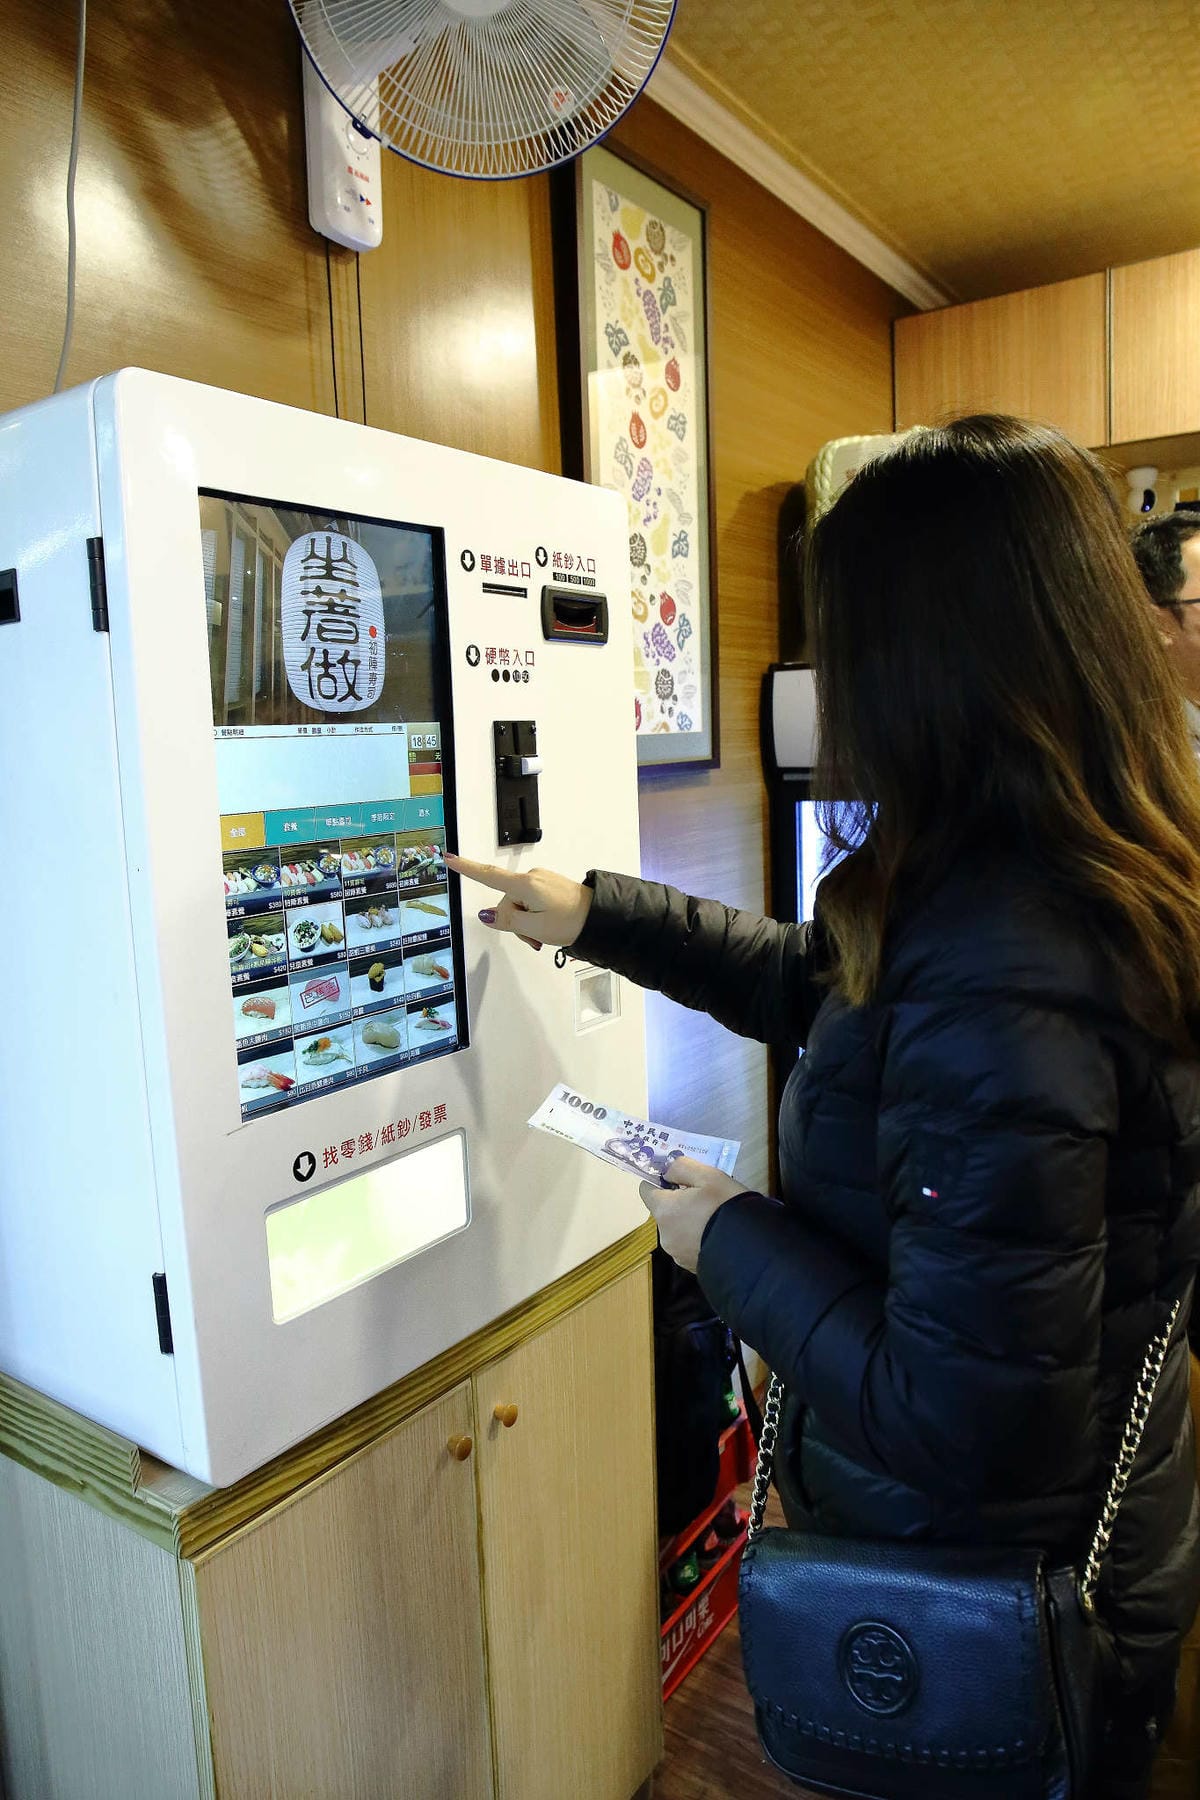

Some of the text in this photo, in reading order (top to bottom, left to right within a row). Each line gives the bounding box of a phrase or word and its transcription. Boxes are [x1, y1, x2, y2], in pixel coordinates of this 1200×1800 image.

[480, 553, 531, 578] 單據出口
[552, 551, 596, 574] 紙鈔入口
[484, 647, 535, 667] 硬幣入口
[273, 964, 286, 974] $420
[559, 1090, 607, 1120] 1000
[322, 1103, 447, 1169] 找零錢/紙鈔/發票
[623, 1119, 670, 1142] 中華民國
